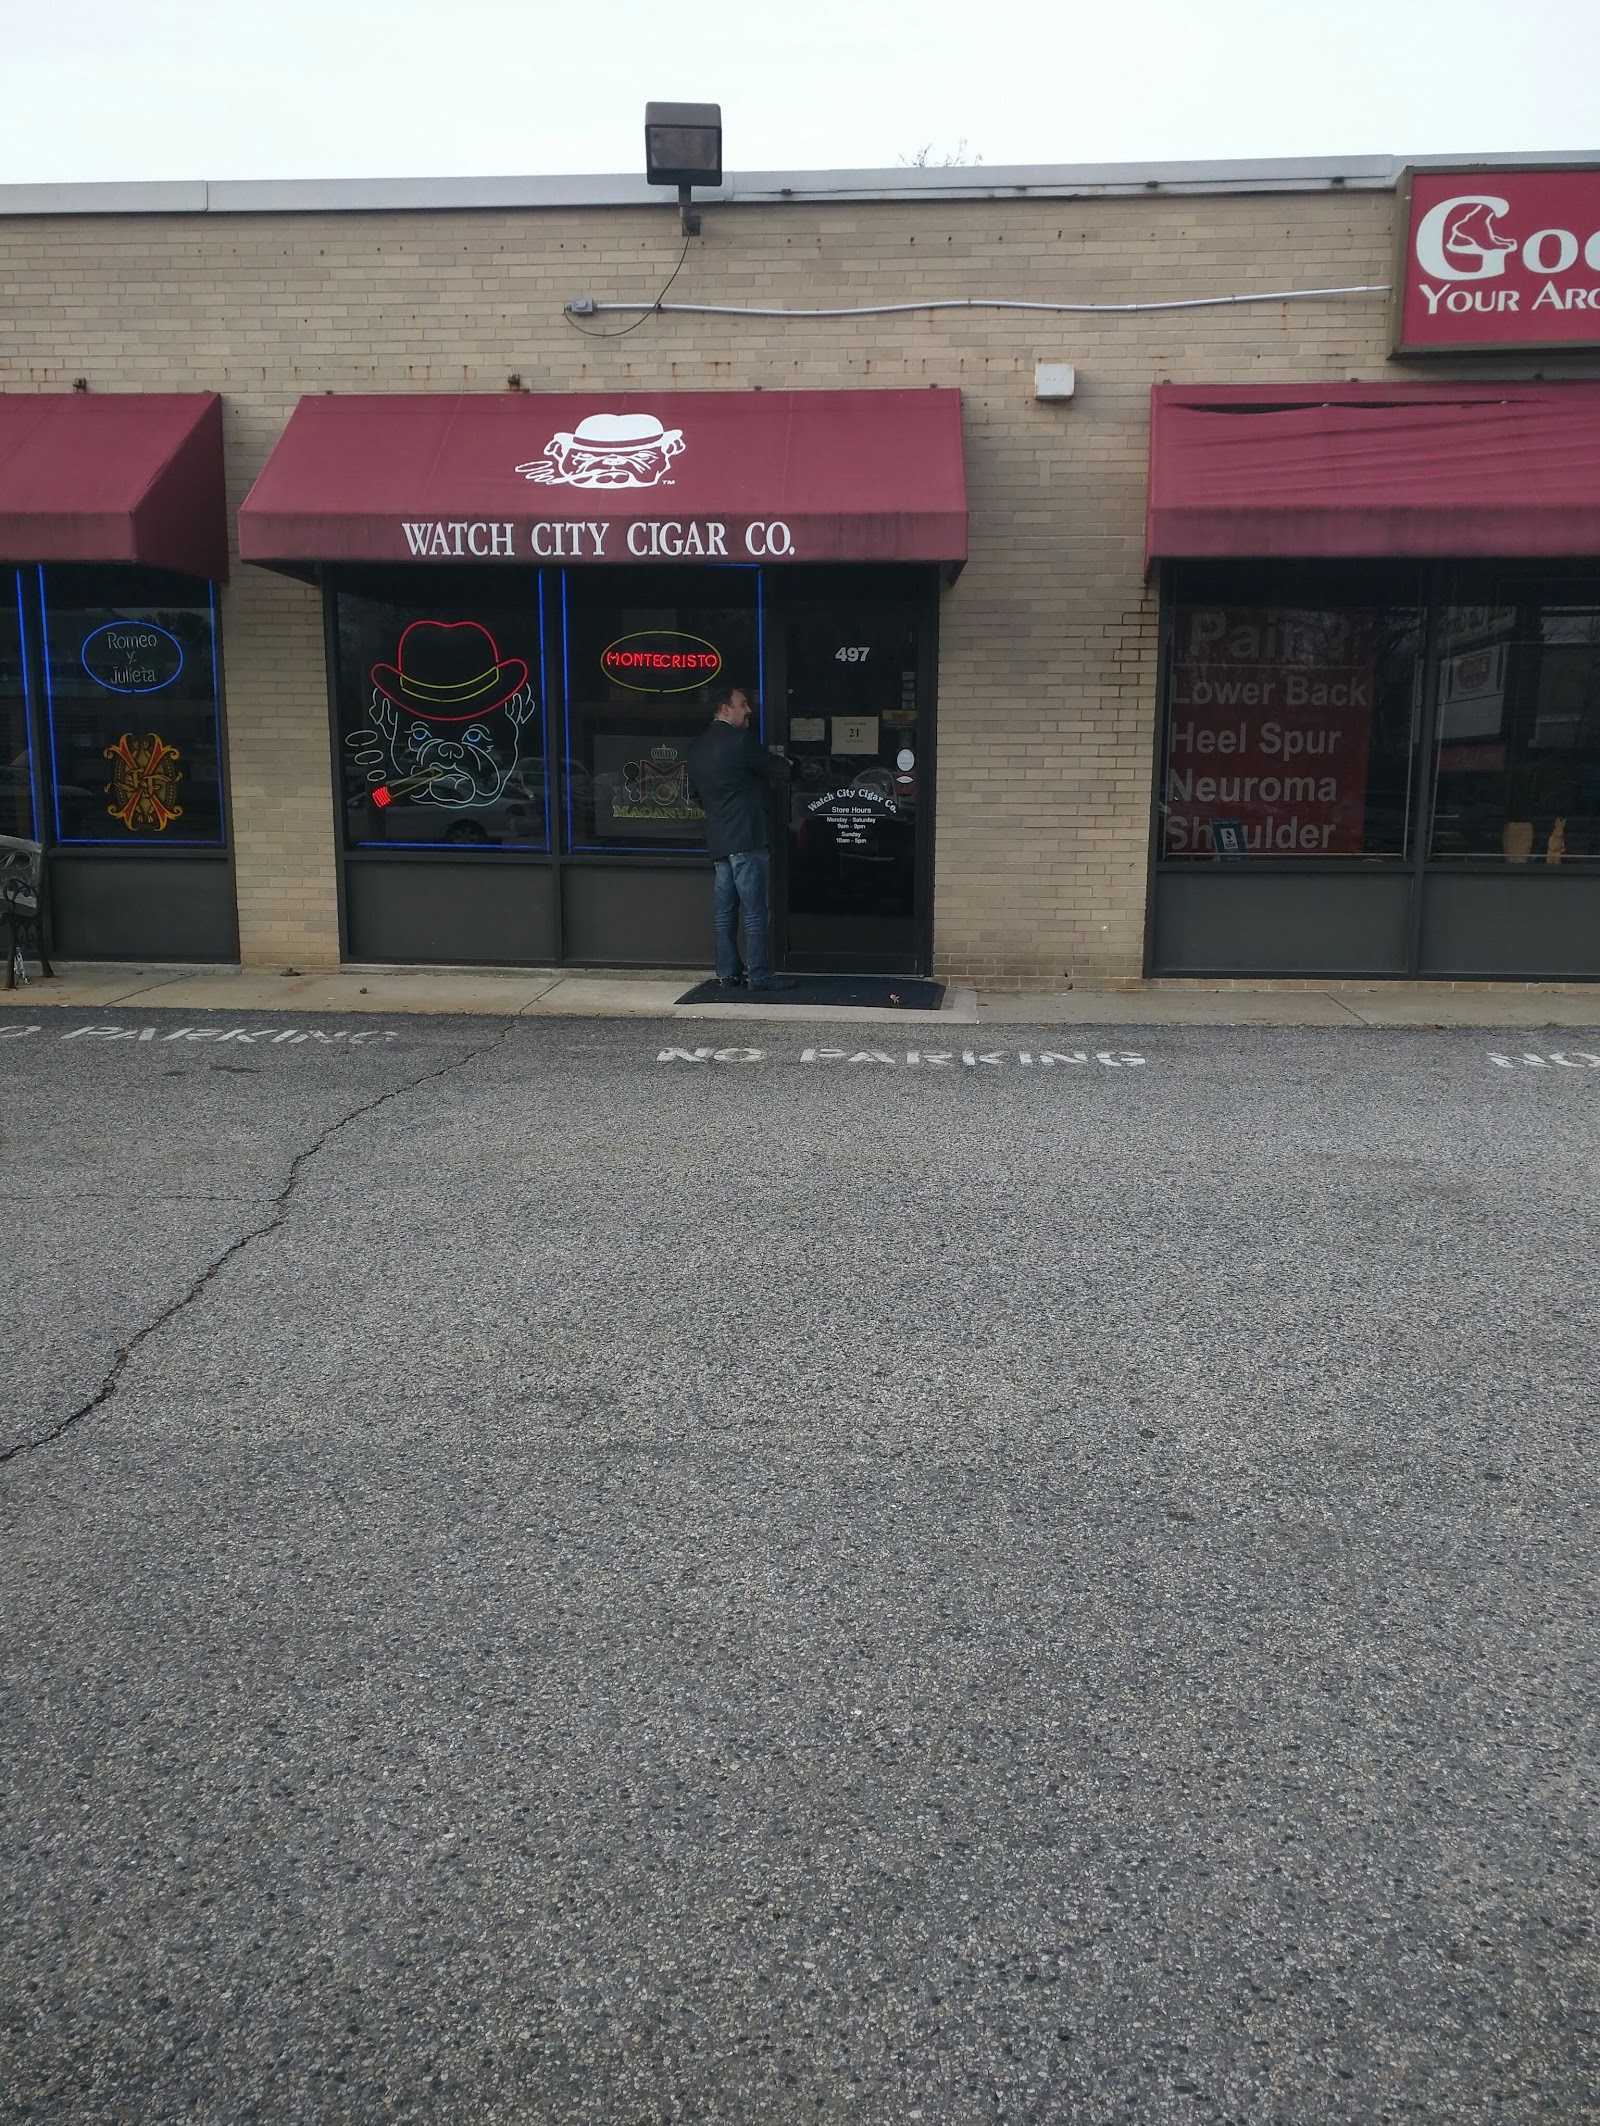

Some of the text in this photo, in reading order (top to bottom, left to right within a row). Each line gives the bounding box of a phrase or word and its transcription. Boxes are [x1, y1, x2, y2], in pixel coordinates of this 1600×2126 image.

[1418, 283, 1520, 315] YOUR
[402, 520, 796, 556] WATCH CITY CIGAR CO.
[106, 632, 158, 650] Romeo
[606, 651, 718, 668] MONTECRISTO
[835, 647, 870, 662] 497
[110, 666, 157, 684] Julieta
[1170, 674, 1369, 707] Lower Back
[849, 728, 860, 738] 21
[1170, 722, 1342, 761] Heel Spur
[1167, 768, 1338, 803] Neuroma
[807, 788, 898, 814] Watch City Cigar Co.
[831, 806, 872, 814] Store Hours
[1167, 815, 1337, 850] Shulder
[657, 1046, 1146, 1067] NO PARKING
